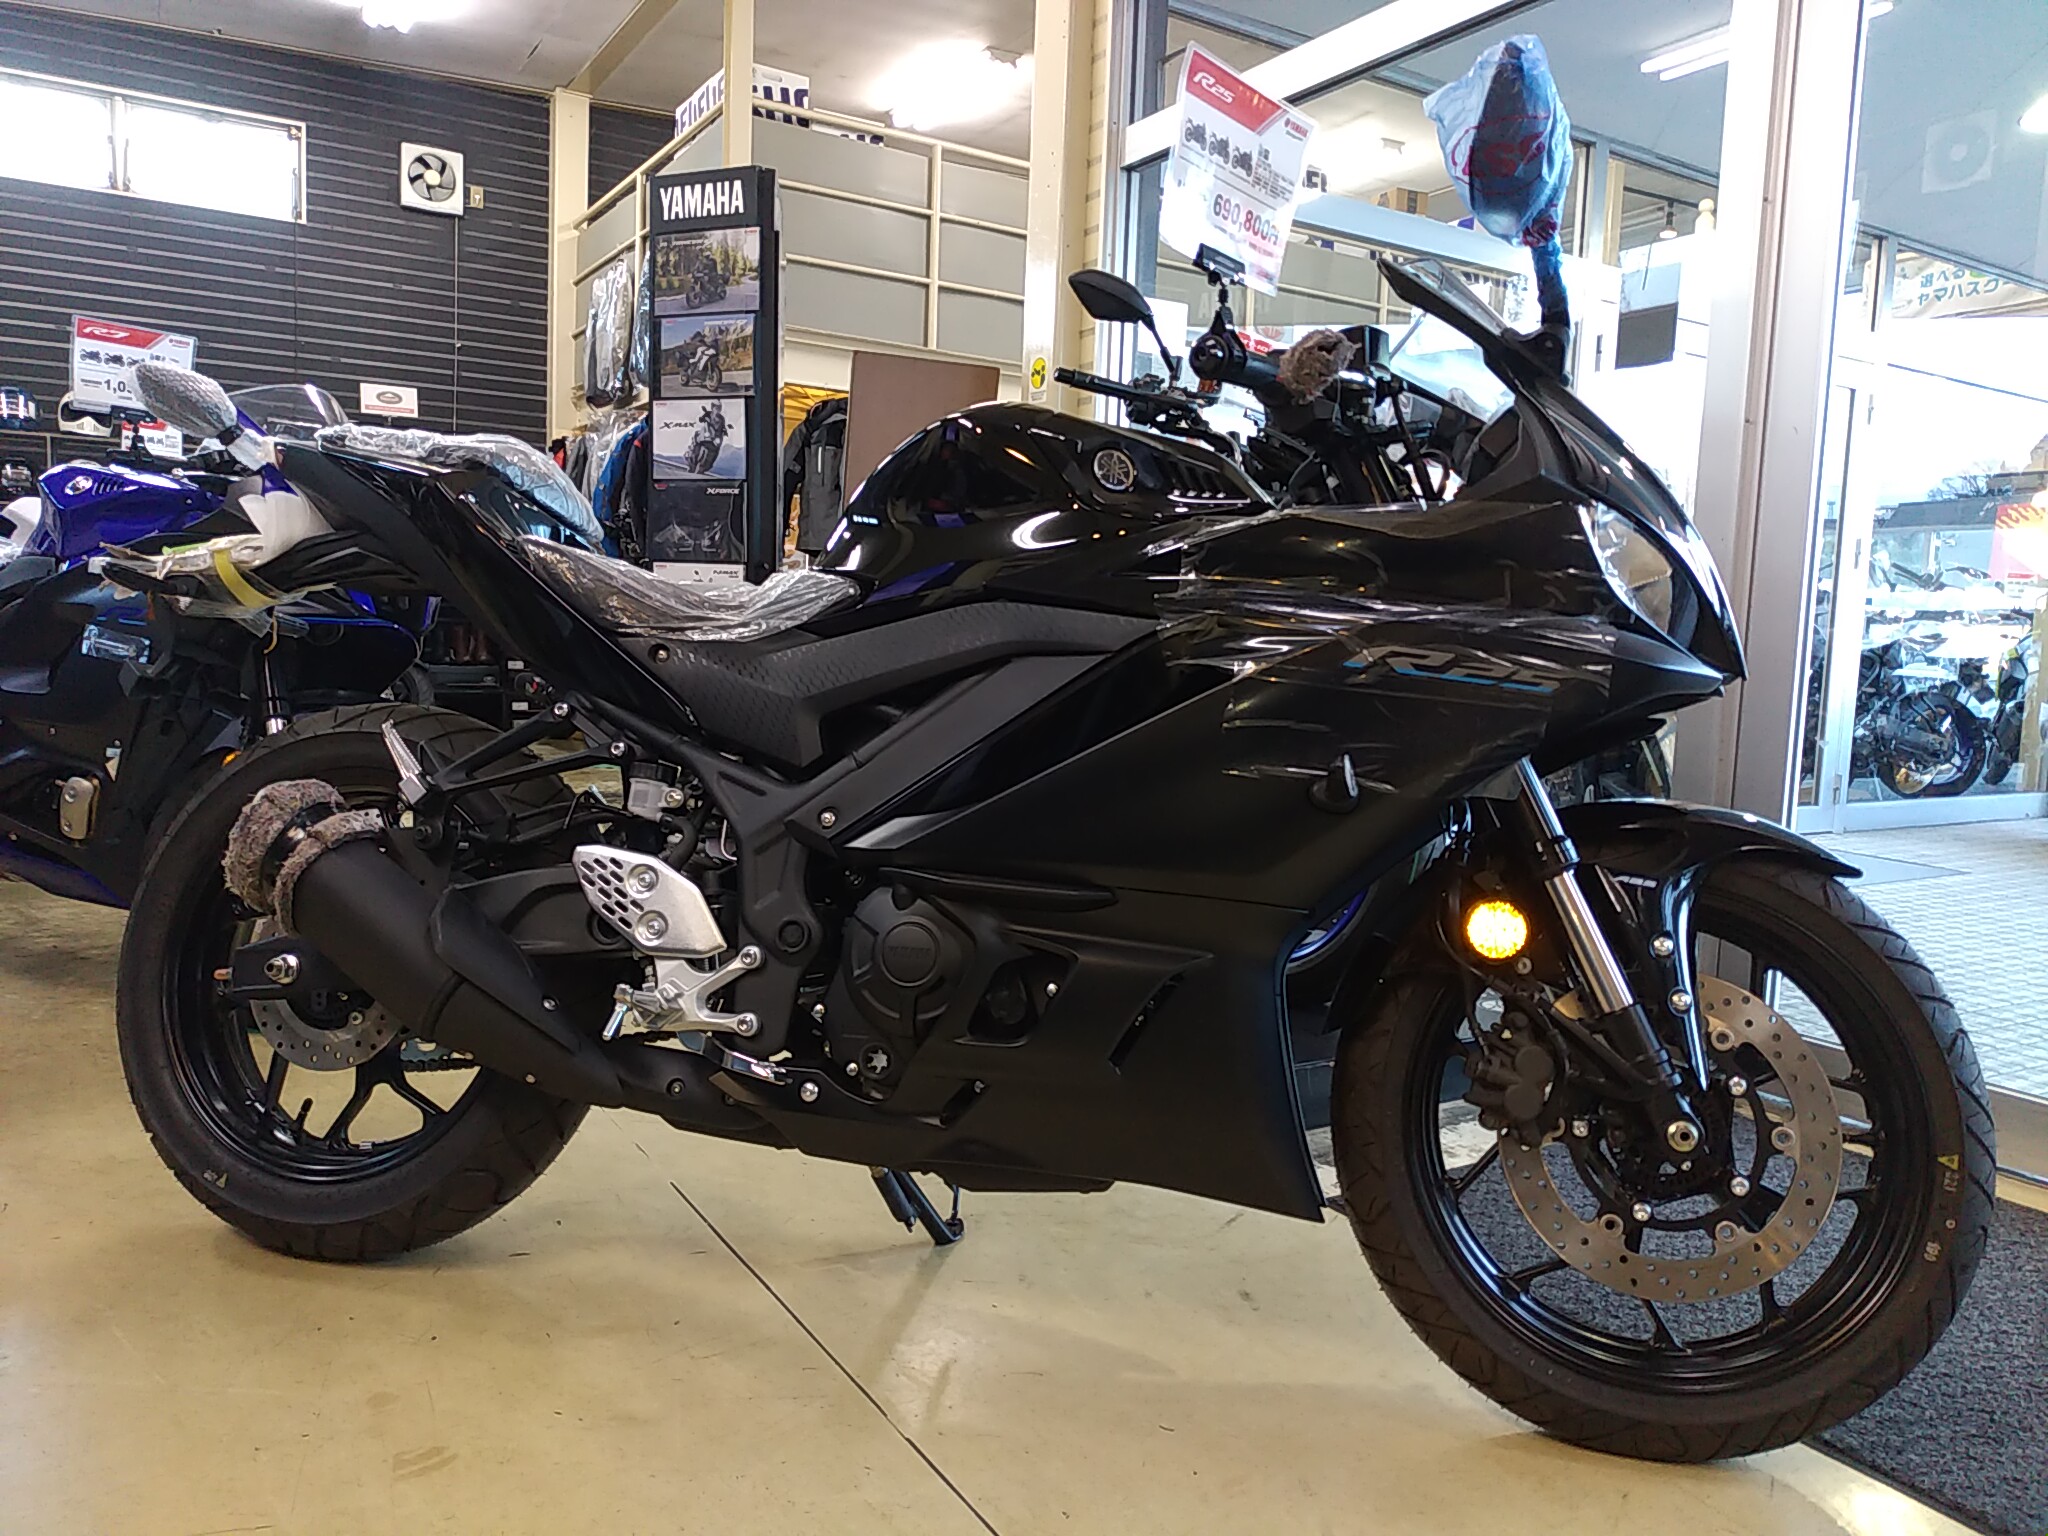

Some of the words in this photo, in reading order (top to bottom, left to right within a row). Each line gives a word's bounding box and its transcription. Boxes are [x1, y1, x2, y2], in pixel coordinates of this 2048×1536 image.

[1193, 71, 1236, 104] R25
[660, 179, 745, 221] YAMAHA
[1343, 645, 1561, 693] R25
